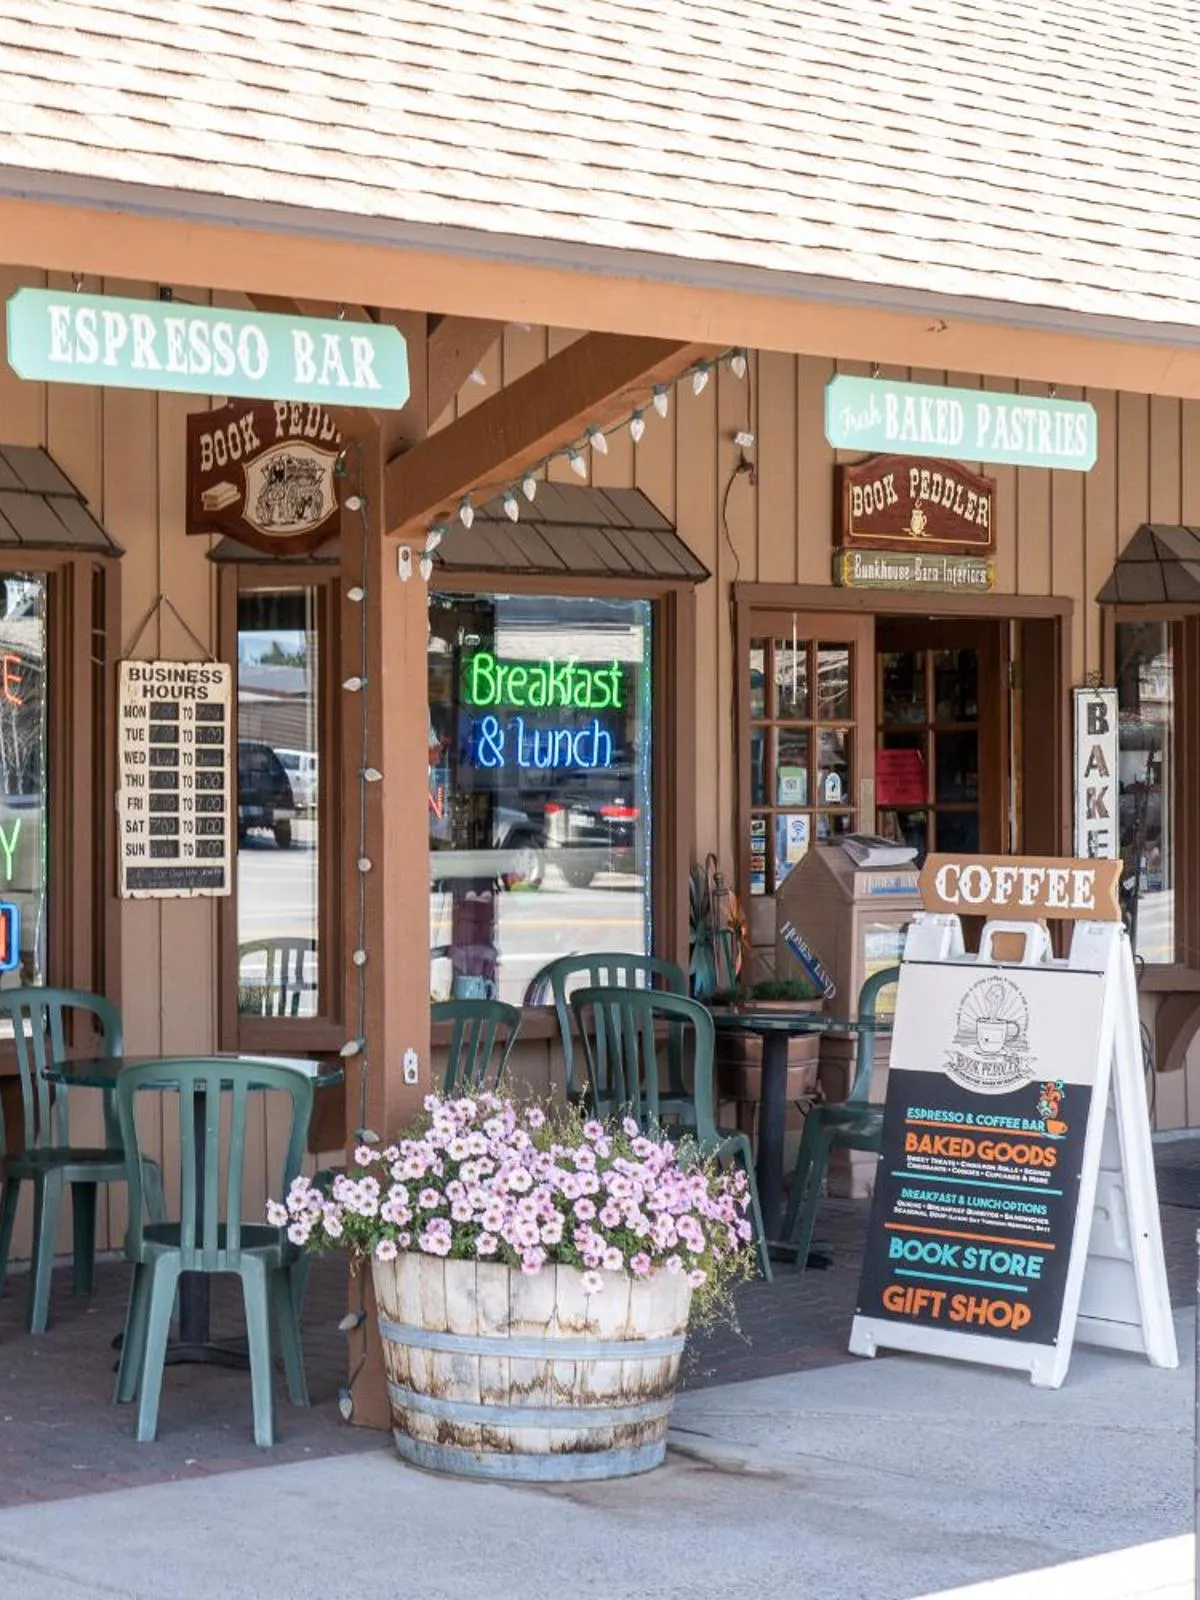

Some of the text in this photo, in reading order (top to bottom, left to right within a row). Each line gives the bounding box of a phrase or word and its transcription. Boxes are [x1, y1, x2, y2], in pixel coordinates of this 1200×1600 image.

[47, 304, 382, 390] ESPRESSO BAR
[200, 400, 342, 472] BOOK PEDD
[884, 393, 964, 446] BAKED
[976, 403, 1088, 457] PASTRIES
[852, 467, 989, 527] BOOK PEDDLER
[854, 554, 987, 587] Bunkhouse Barn Interiors
[129, 667, 223, 683] BUSINESS
[472, 653, 623, 709] Breakfast
[142, 684, 209, 699] HOURS
[124, 704, 193, 719] MON TO
[125, 728, 193, 743] TUE TO
[478, 716, 504, 768] &
[124, 751, 193, 765] WED TO
[125, 773, 193, 788] THU TO
[128, 797, 193, 811] FRI TO
[125, 820, 193, 834] SAT TO
[126, 843, 194, 856] SUN TO
[935, 864, 1096, 910] COFFEE
[907, 1107, 1046, 1132] ESPRESSO & COFFEE BAR
[905, 1132, 1057, 1167] BAKED GOODS
[901, 1187, 1048, 1216] BREAKFAST & LUNCH OPTIONS
[888, 1236, 1044, 1279] BOOK STORE
[883, 1284, 1032, 1331] GIFT SHOP
